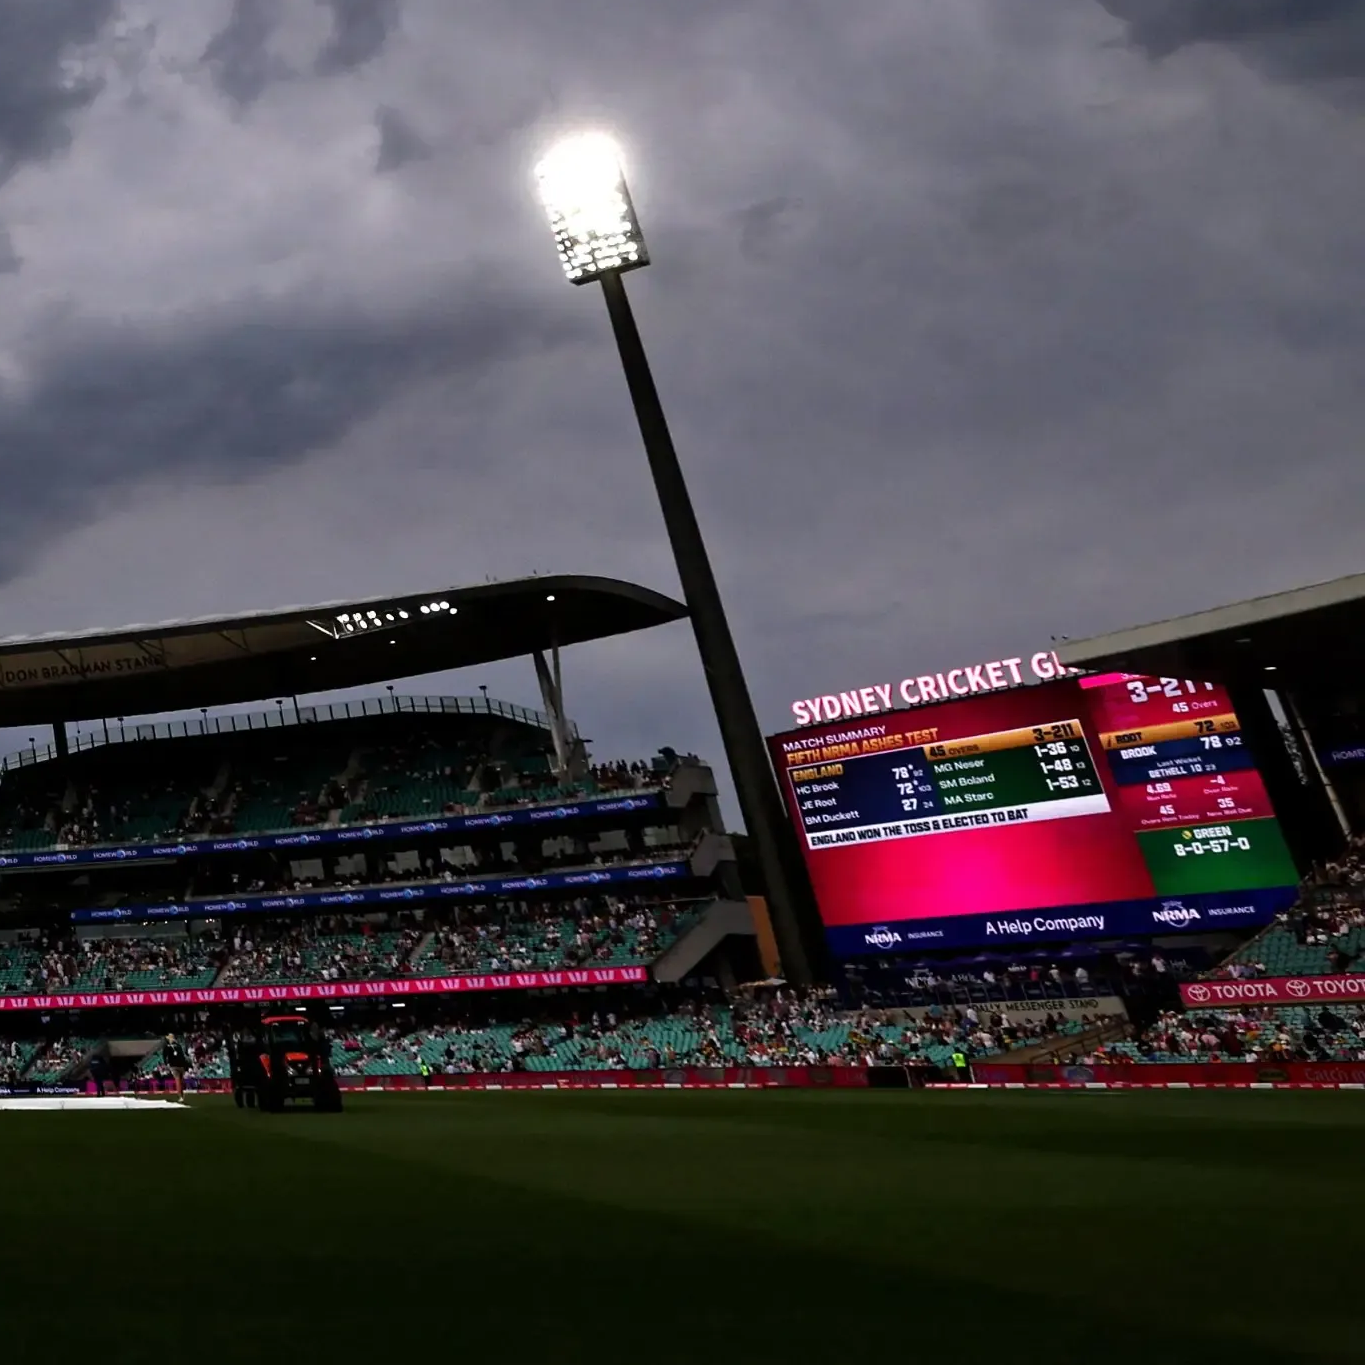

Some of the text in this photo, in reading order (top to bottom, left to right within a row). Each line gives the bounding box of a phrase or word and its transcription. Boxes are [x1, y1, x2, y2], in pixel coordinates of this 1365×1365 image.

[6, 669, 37, 683] DON
[792, 684, 892, 725] SYDNEY
[900, 658, 1022, 704] CRICKET
[1172, 700, 1218, 713] 45 Overs
[1194, 720, 1216, 733] 72
[783, 726, 886, 752] MATCH SUMMARY
[787, 728, 938, 766] FIFTH NRMA ASHES TEST
[929, 745, 946, 757] 45
[1032, 723, 1074, 742] 3-211
[1120, 736, 1242, 760] BROOK 78 92
[934, 762, 953, 773] MG
[954, 759, 985, 771] Neser
[1034, 741, 1067, 757] 1-36
[793, 764, 844, 782] ENGLAND
[939, 758, 1073, 789] SM Boland 1-48
[1190, 763, 1203, 773] 10
[797, 786, 811, 795] HC
[813, 782, 840, 793] Brook
[944, 796, 962, 805] MA
[964, 792, 995, 803] Starc
[1046, 775, 1080, 791] 1-53
[802, 801, 813, 810] JE
[815, 797, 837, 808] Root
[805, 815, 821, 825] BM
[822, 810, 860, 823] Duckett
[901, 798, 917, 811] 27
[1159, 804, 1176, 815] 45
[1217, 797, 1235, 808] 35
[811, 808, 1028, 846] ENGLAND WON THE TOSS & ELECTED TO BAT
[1193, 826, 1232, 839] GREEN
[1174, 837, 1250, 856] 8-0-57-0
[1152, 905, 1256, 923] NRMA INSURANCE
[985, 915, 1105, 935] A Help Company
[865, 932, 902, 945] NRMA
[1213, 982, 1278, 999] TOYOTA
[1005, 1000, 1065, 1012] MESSENGER
[1069, 999, 1099, 1009] STAND
